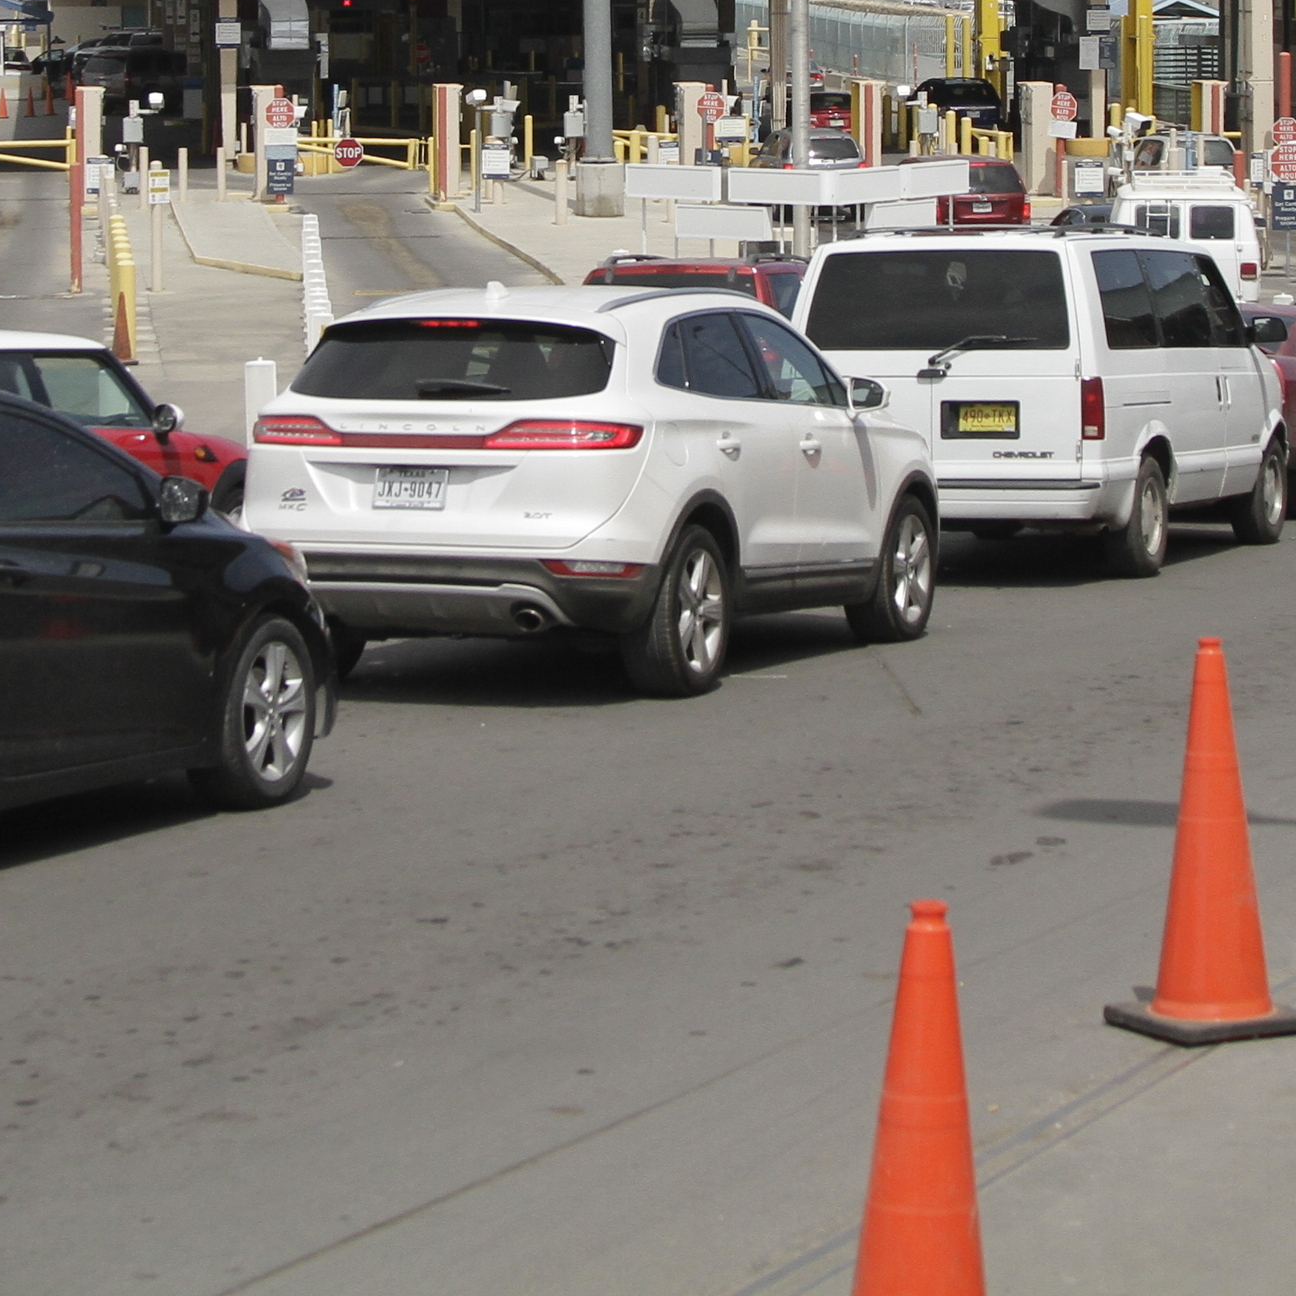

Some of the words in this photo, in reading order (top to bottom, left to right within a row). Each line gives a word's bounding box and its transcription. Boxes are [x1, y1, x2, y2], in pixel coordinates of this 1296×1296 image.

[336, 147, 361, 159] STOP
[1280, 172, 1296, 180] AQUI
[340, 422, 487, 432] LINCOLN
[992, 451, 1055, 459] CHEVROLET
